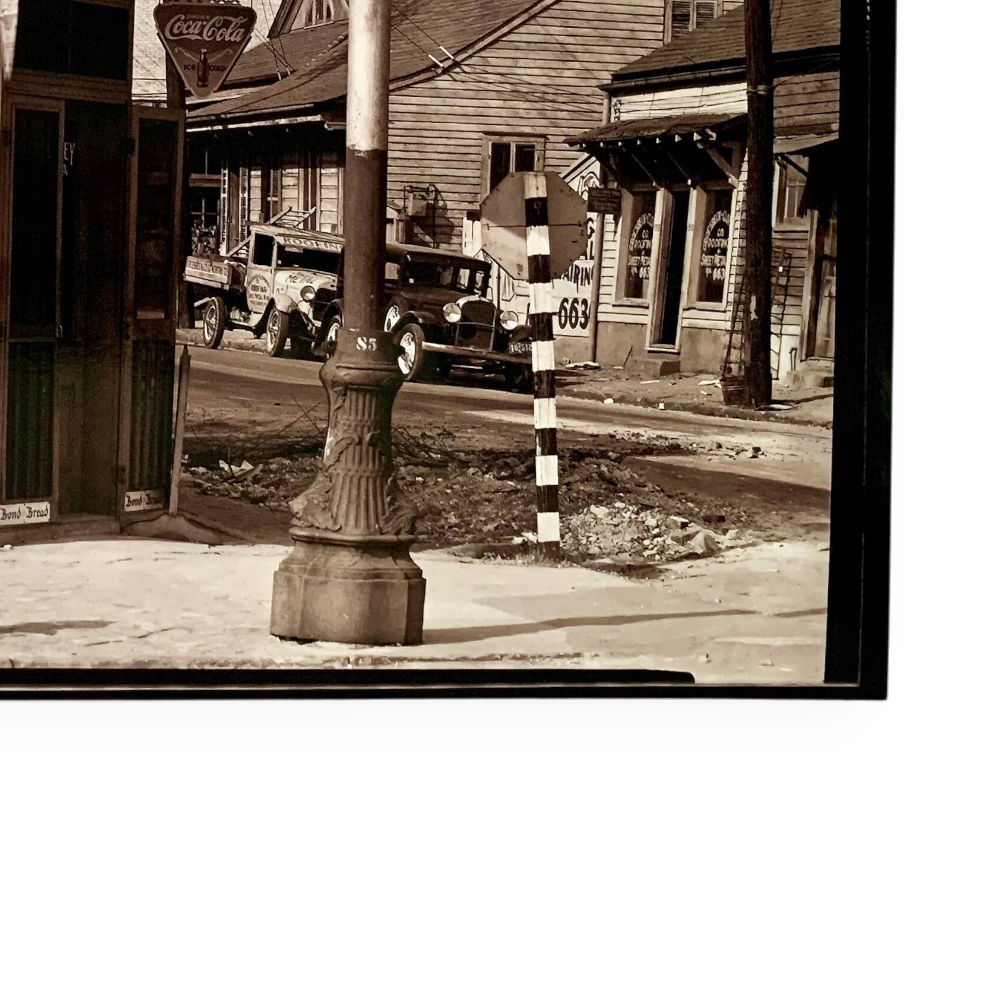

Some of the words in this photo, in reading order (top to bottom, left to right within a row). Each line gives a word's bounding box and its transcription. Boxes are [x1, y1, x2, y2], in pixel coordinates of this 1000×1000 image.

[164, 13, 248, 42] Coca-Cola
[282, 238, 342, 250] ROOFIN
[558, 297, 589, 330] 663
[356, 336, 377, 351] 85
[0, 506, 22, 521] Bond
[26, 505, 49, 519] Bread
